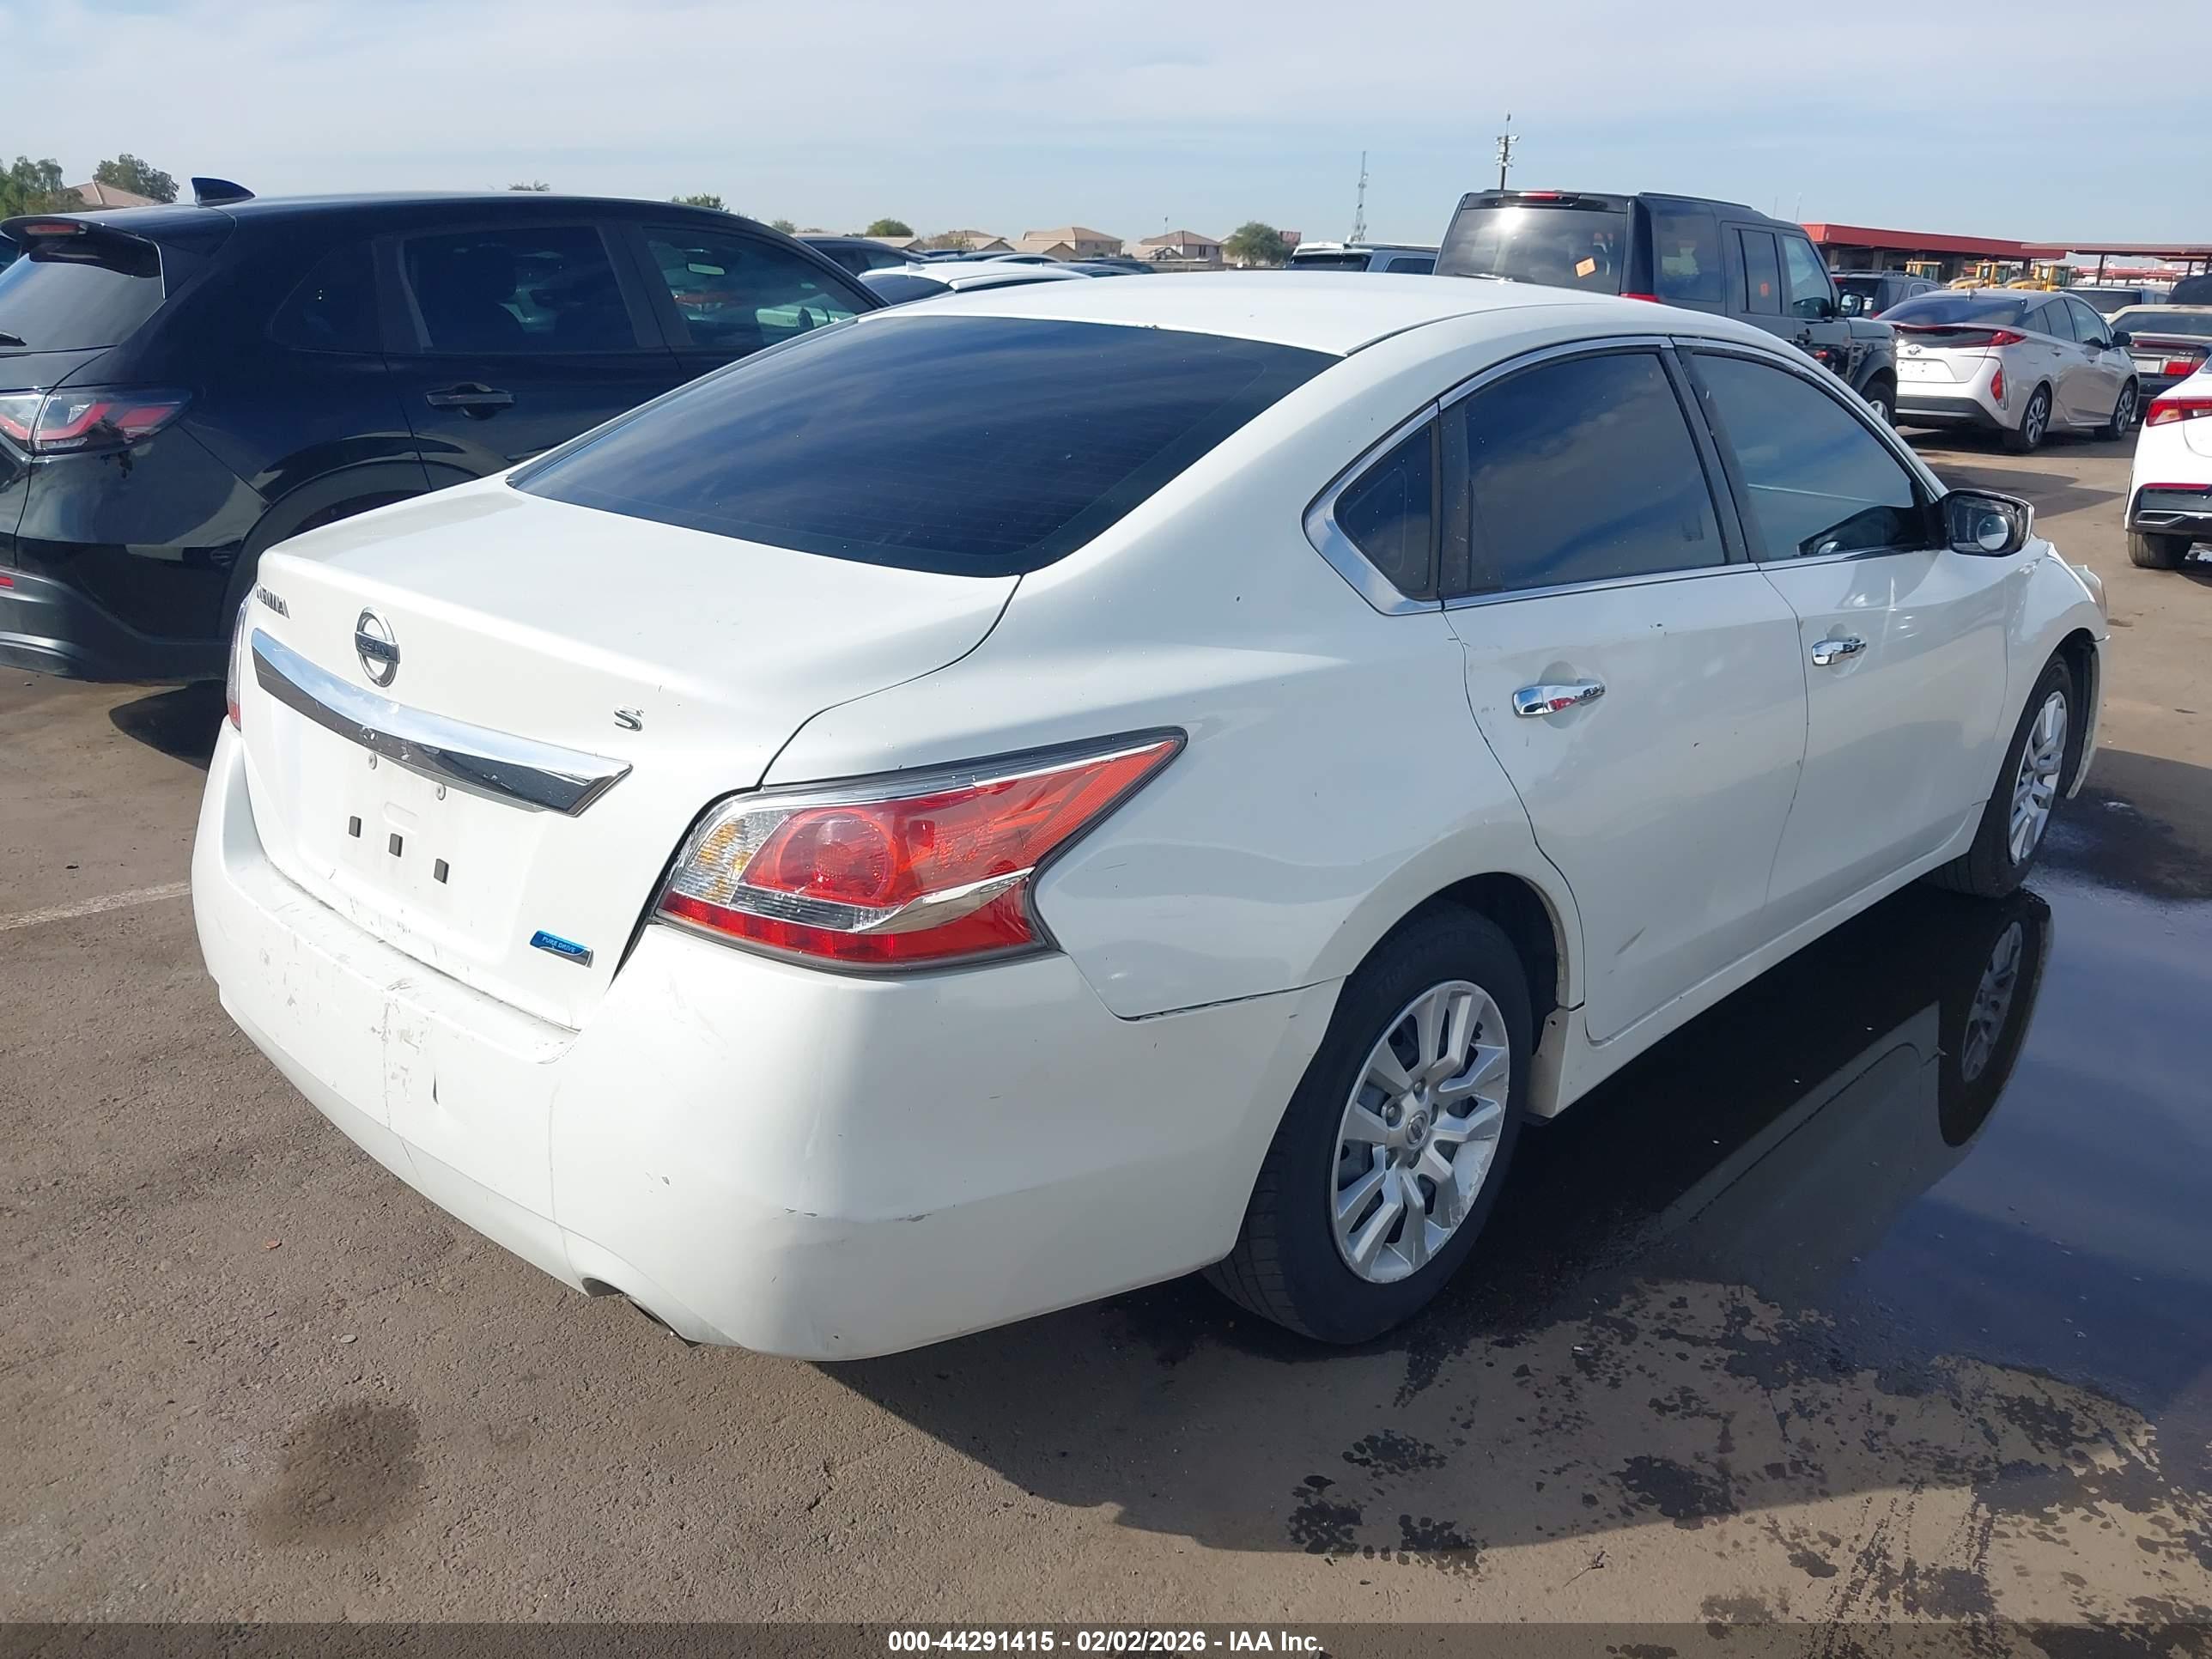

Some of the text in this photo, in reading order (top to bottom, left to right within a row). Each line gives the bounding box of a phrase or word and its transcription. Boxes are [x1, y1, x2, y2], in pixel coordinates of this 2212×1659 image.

[614, 707, 643, 732] S
[542, 936, 576, 953] PURE DRIVE
